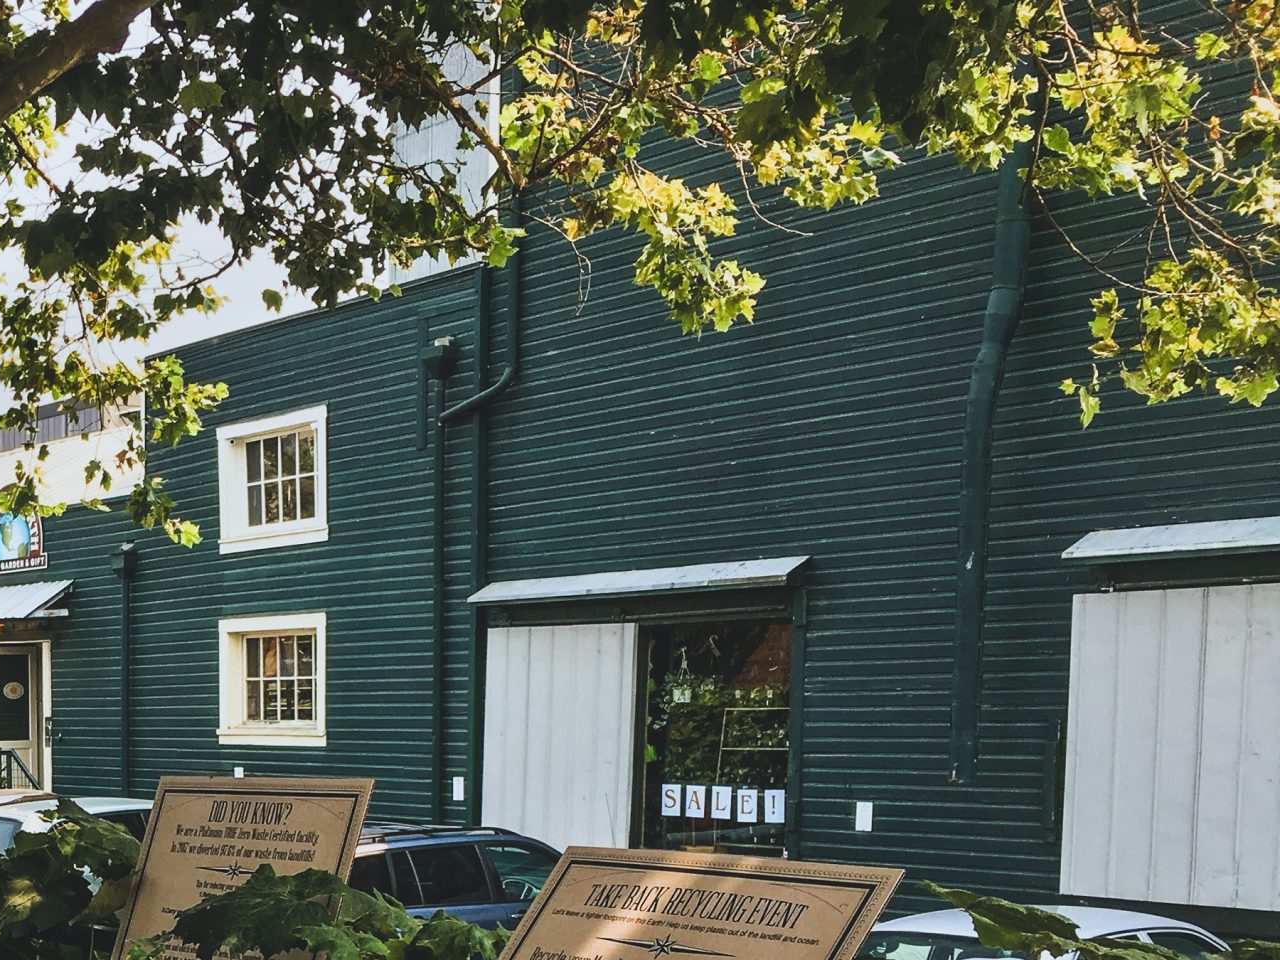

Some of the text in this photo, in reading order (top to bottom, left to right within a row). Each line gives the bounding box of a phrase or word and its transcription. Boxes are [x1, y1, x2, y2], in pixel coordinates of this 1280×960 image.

[1, 560, 24, 570] GARDEN
[25, 559, 30, 567] &
[30, 557, 45, 566] GIFT
[208, 800, 293, 825] DID YOU KNOW?
[583, 884, 810, 929] TAKE BACK RECYCLING EVENT
[666, 921, 680, 930] Help
[689, 924, 704, 934] keep
[704, 926, 726, 935] plastic
[760, 932, 782, 941] landfill
[782, 935, 796, 943] and
